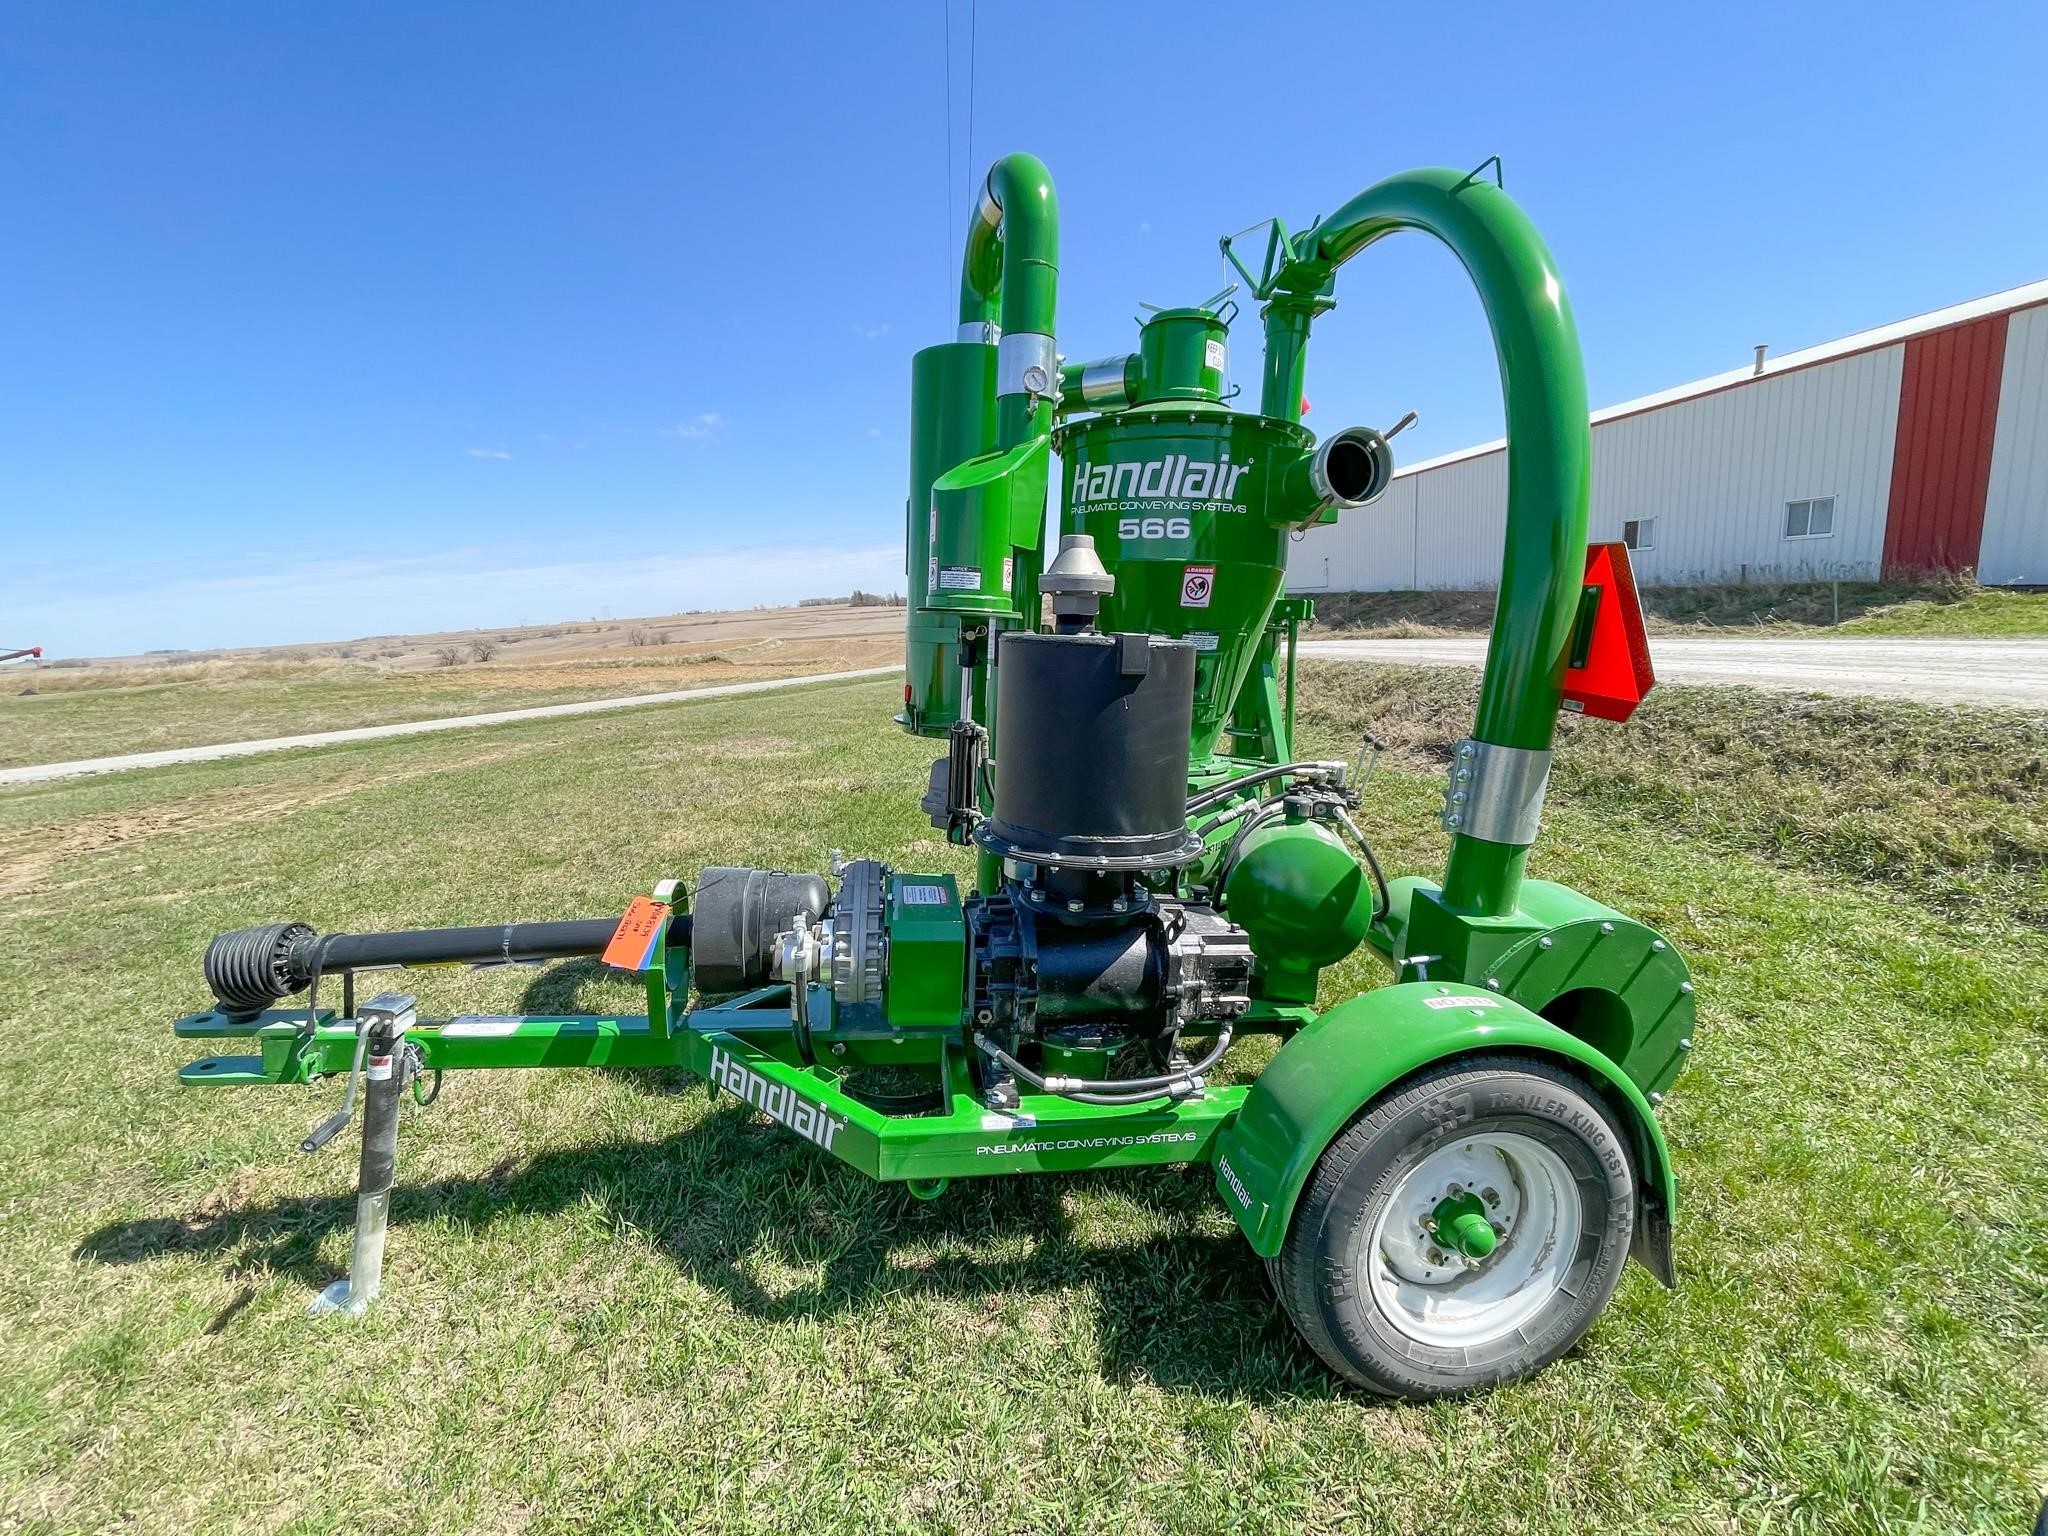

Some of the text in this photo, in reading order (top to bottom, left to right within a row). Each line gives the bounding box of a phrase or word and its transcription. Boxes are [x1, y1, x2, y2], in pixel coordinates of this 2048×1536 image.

[1072, 454, 1250, 504] Handlair
[1071, 501, 1247, 516] PNEUMATIC CONVEYING SYSTEMS
[1117, 518, 1190, 540] 566
[710, 1045, 844, 1151] Handlair
[976, 1131, 1197, 1156] PNEUMATIC CONVEYING SYSTEMS
[1488, 1092, 1626, 1179] TRAILER KING RST
[1218, 1154, 1253, 1210] Handlair
